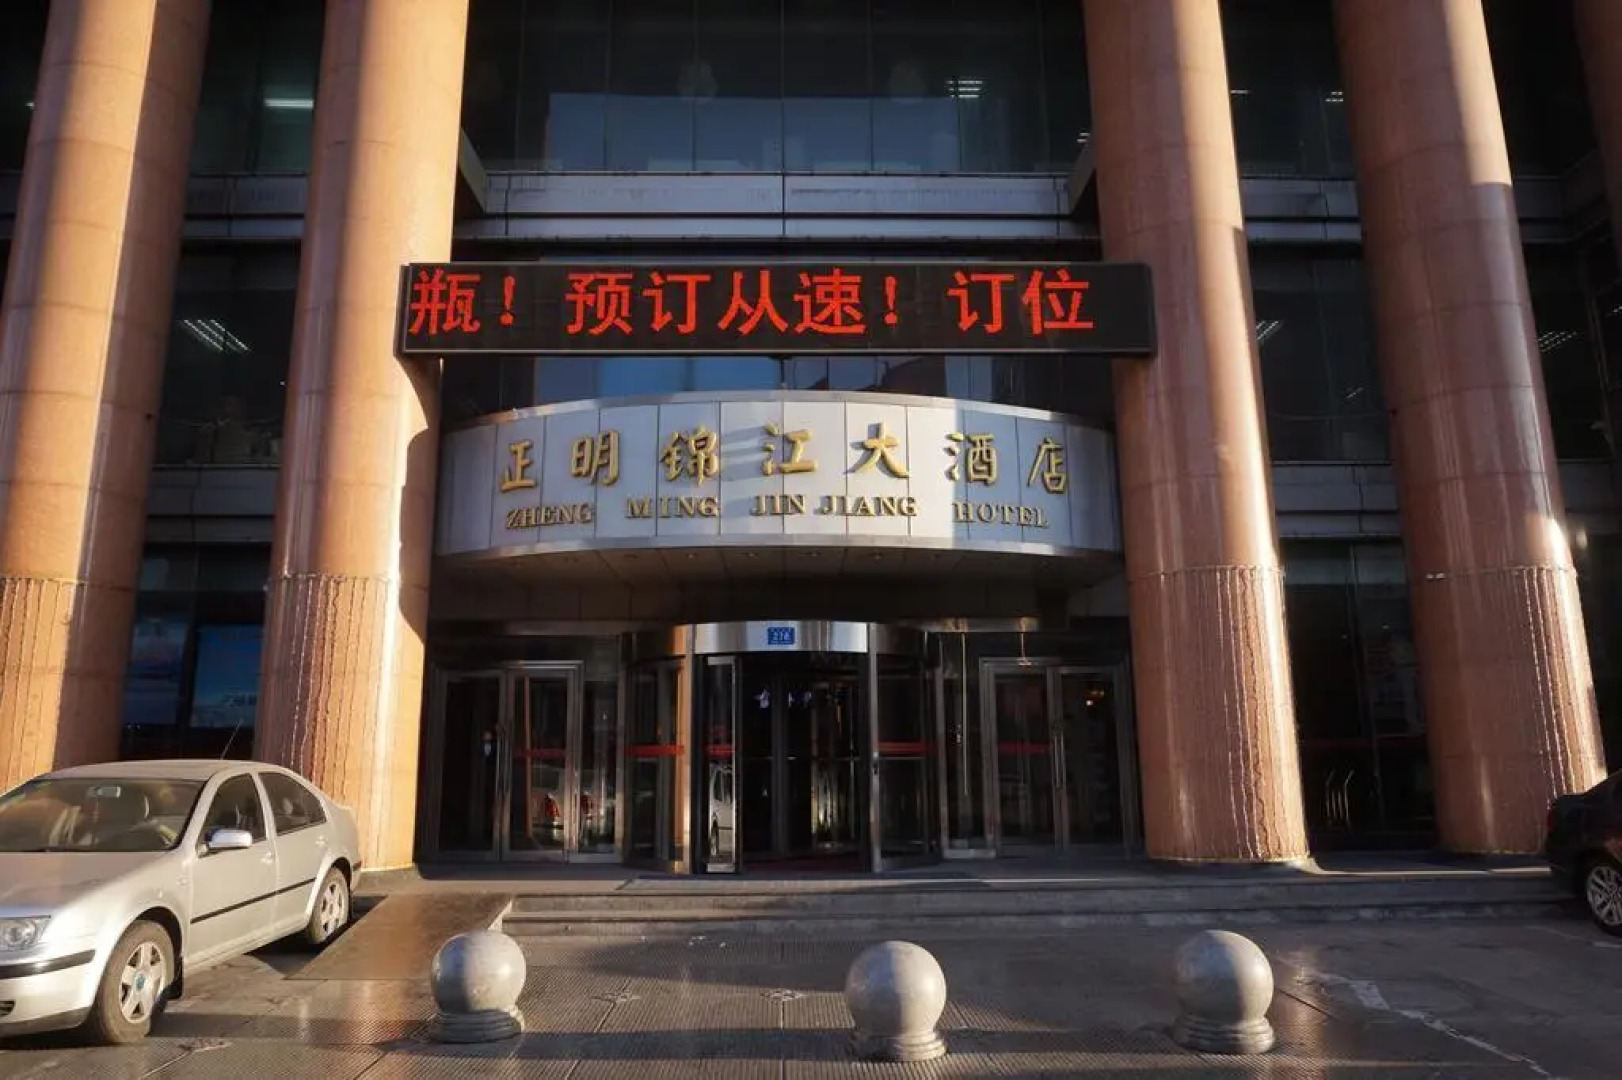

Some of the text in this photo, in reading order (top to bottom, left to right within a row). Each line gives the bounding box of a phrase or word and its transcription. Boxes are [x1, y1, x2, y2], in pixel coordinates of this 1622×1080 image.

[501, 423, 1069, 493] 正明锦江大酒店
[506, 495, 1050, 529] ZHENG MING JIN JIANG HOTEL
